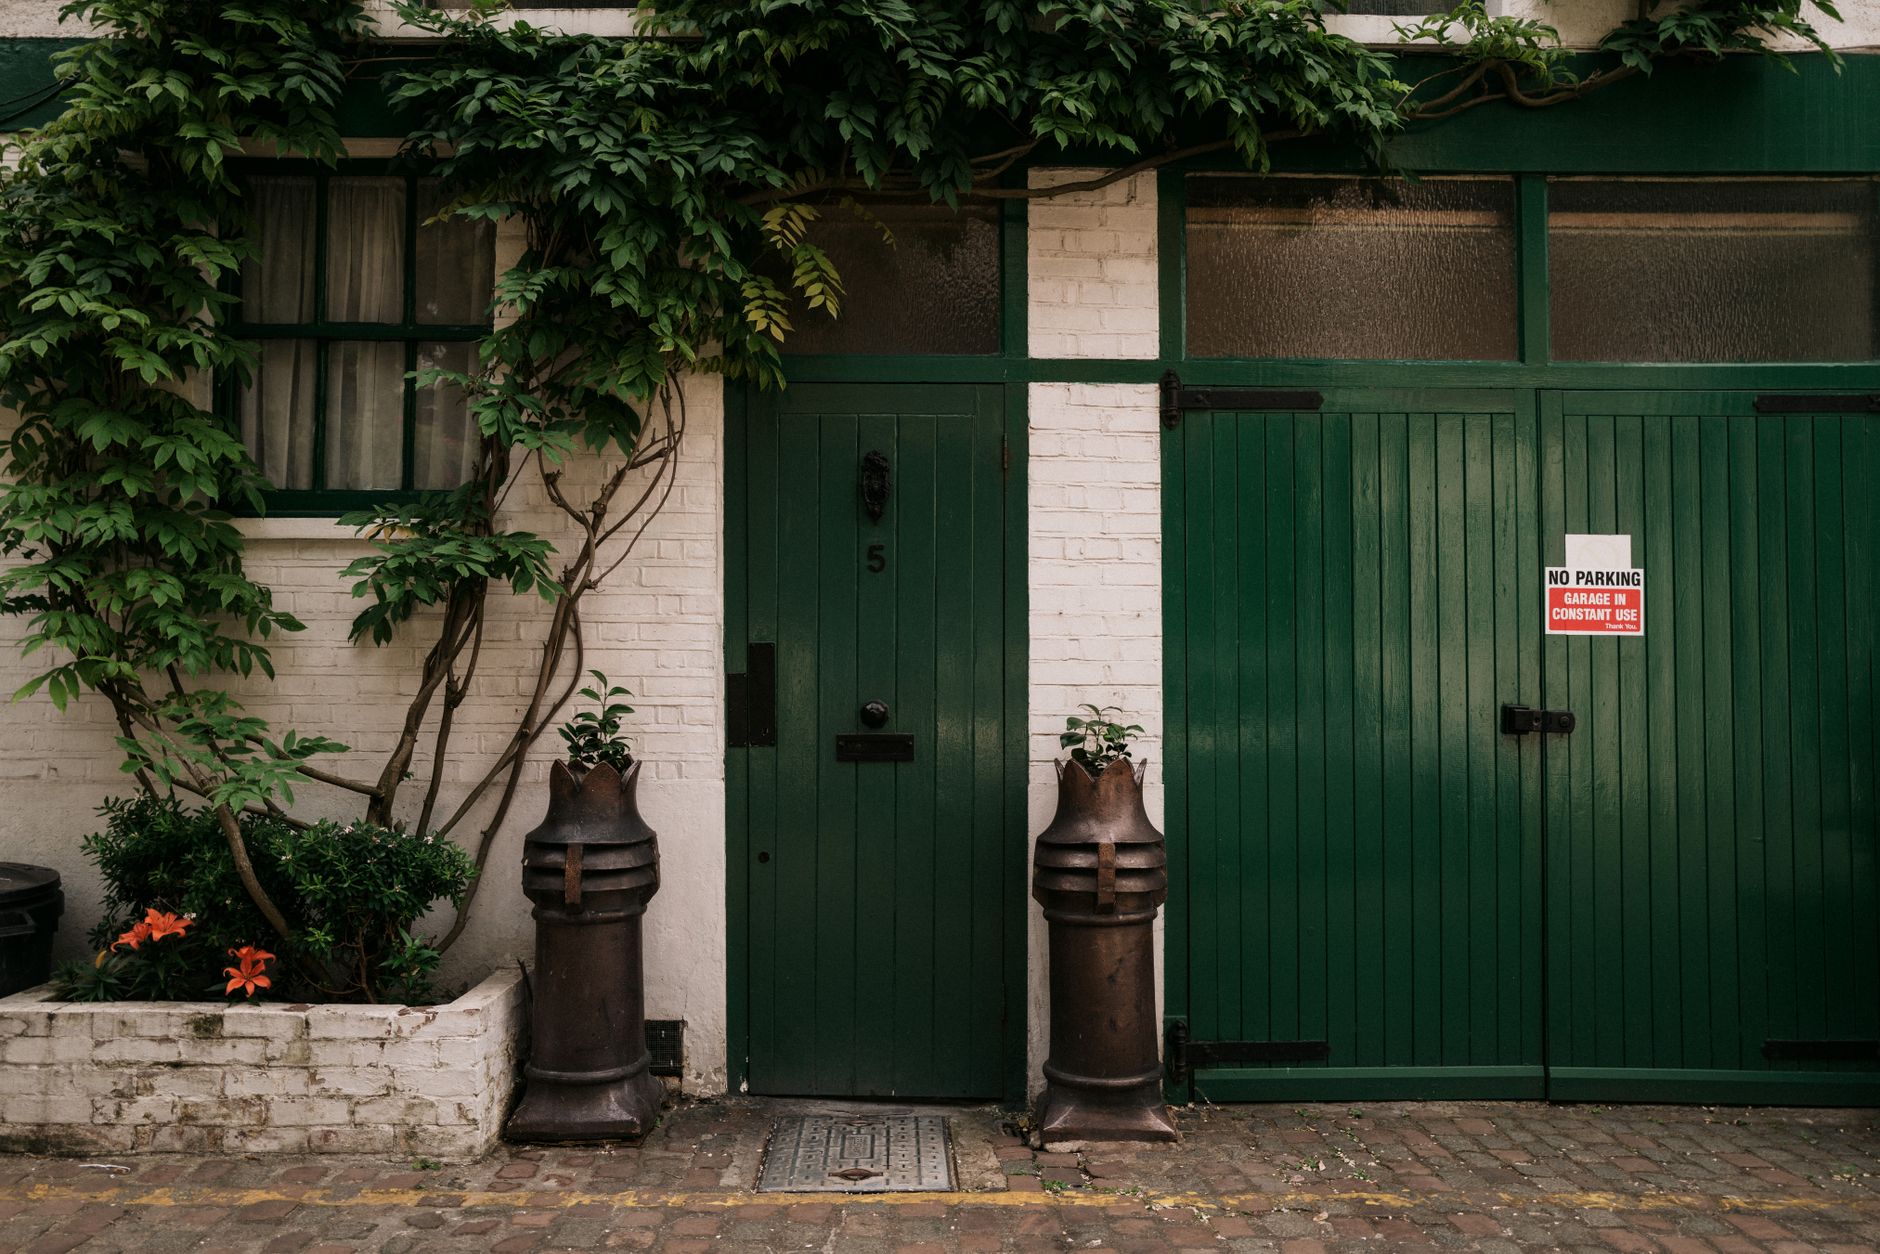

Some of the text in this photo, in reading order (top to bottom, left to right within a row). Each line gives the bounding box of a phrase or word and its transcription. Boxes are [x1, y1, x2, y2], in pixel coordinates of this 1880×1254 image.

[867, 545, 886, 573] 5
[1549, 571, 1641, 586] NO PARKING
[1564, 592, 1626, 605] GARAGE IN
[1552, 608, 1638, 621] CONSTANT USE
